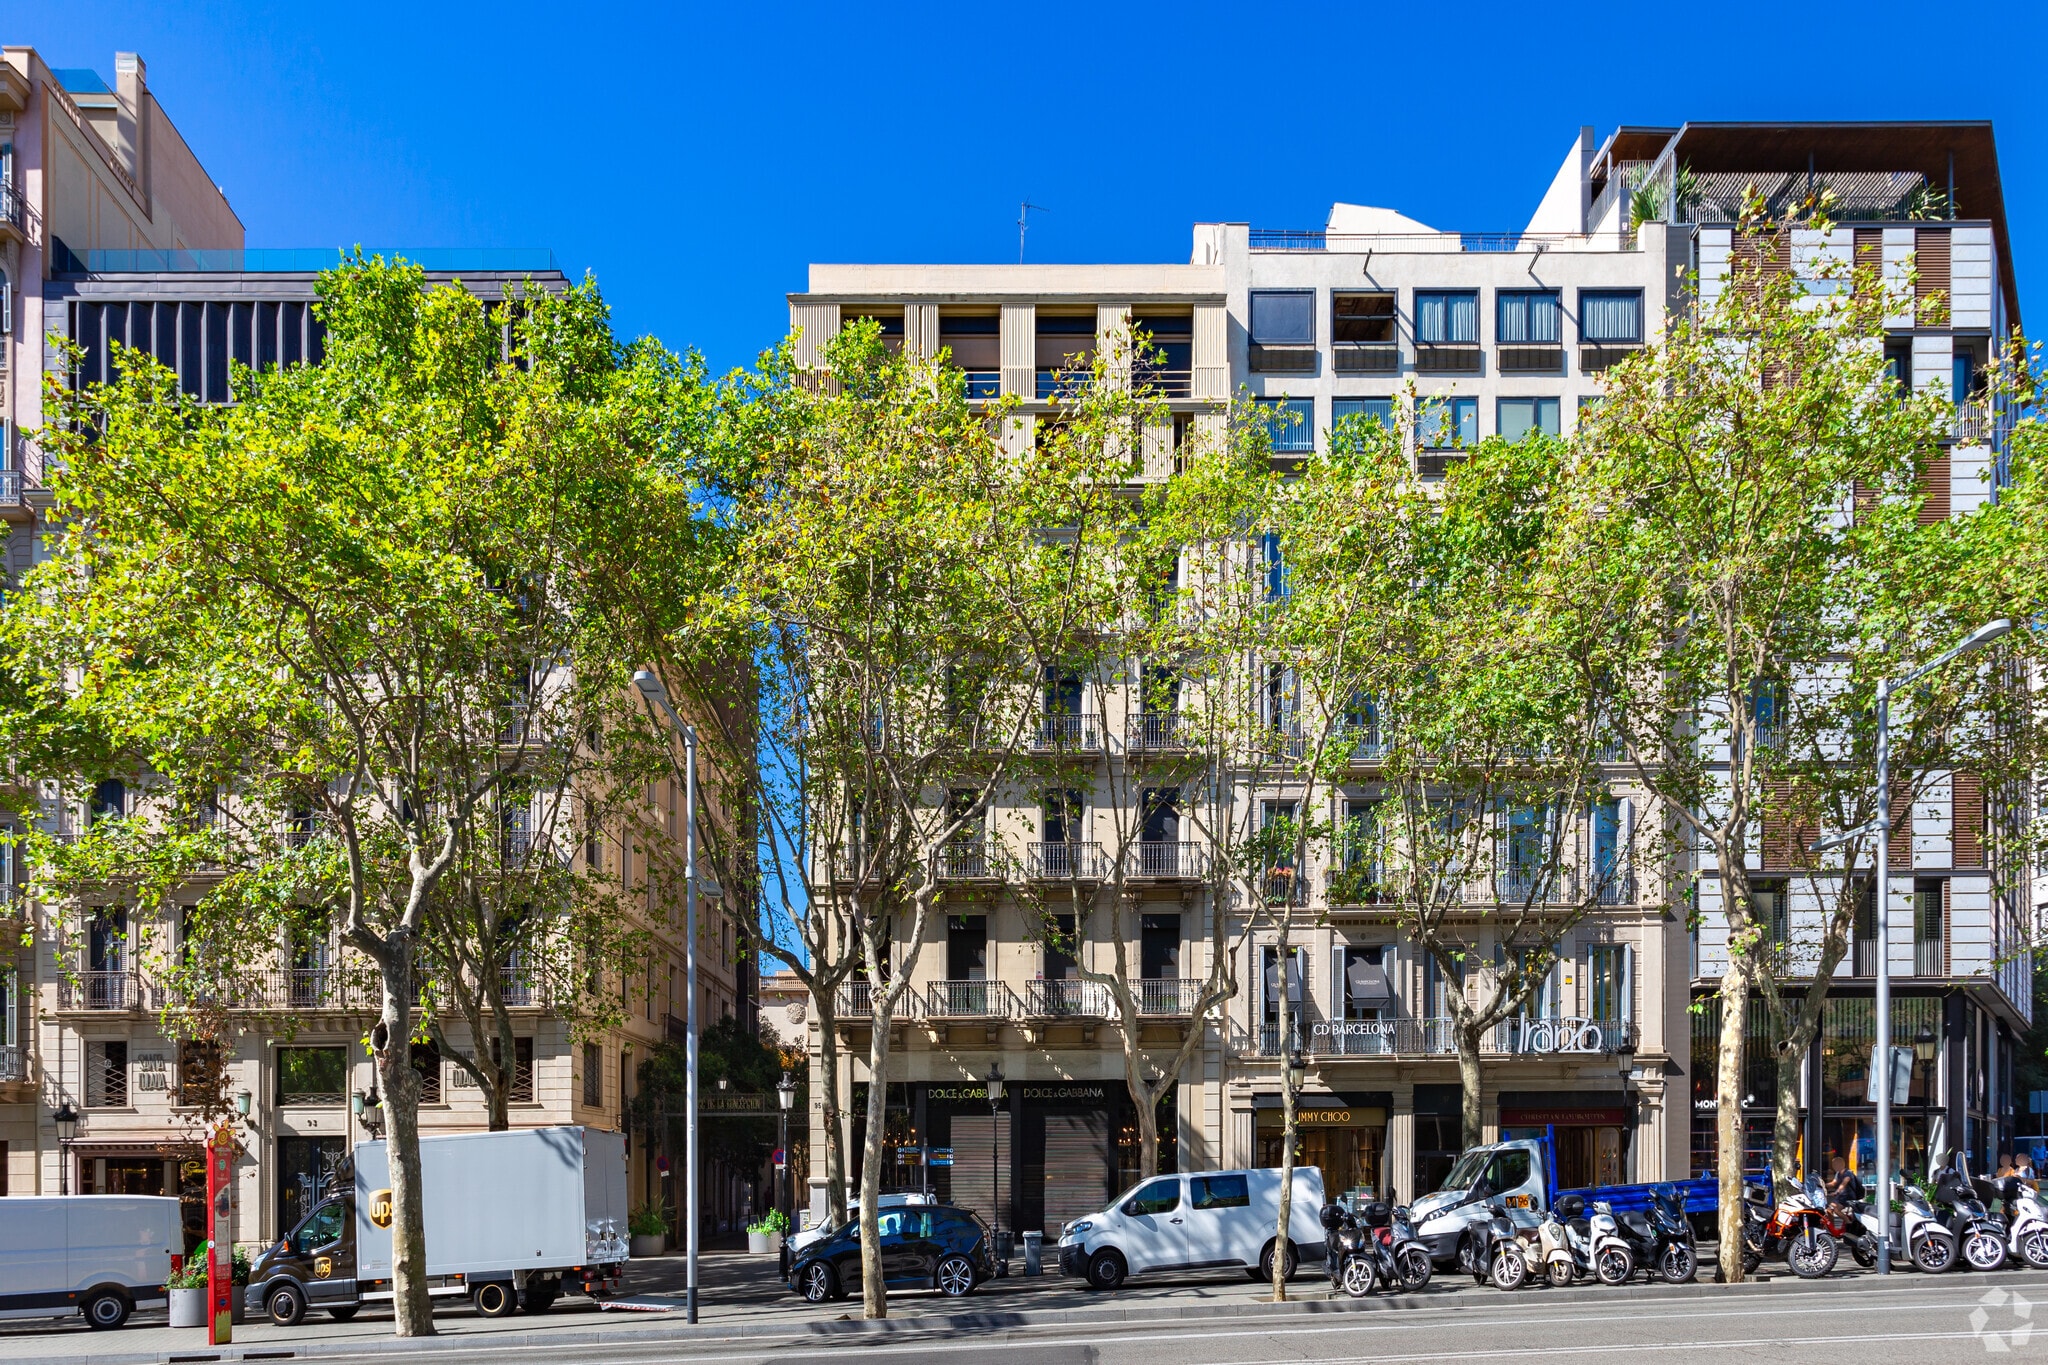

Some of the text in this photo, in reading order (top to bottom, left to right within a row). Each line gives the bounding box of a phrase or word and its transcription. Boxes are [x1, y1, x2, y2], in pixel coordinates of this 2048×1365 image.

[1313, 1023, 1395, 1035] CD BARCELONA
[928, 1088, 957, 1099] DOLCE
[963, 1088, 1009, 1098] GABBA
[1023, 1088, 1053, 1098] DOLCE
[1058, 1088, 1104, 1098] GABBANA
[1298, 1111, 1350, 1122] IMMY CHOO
[315, 1262, 330, 1276] ups
